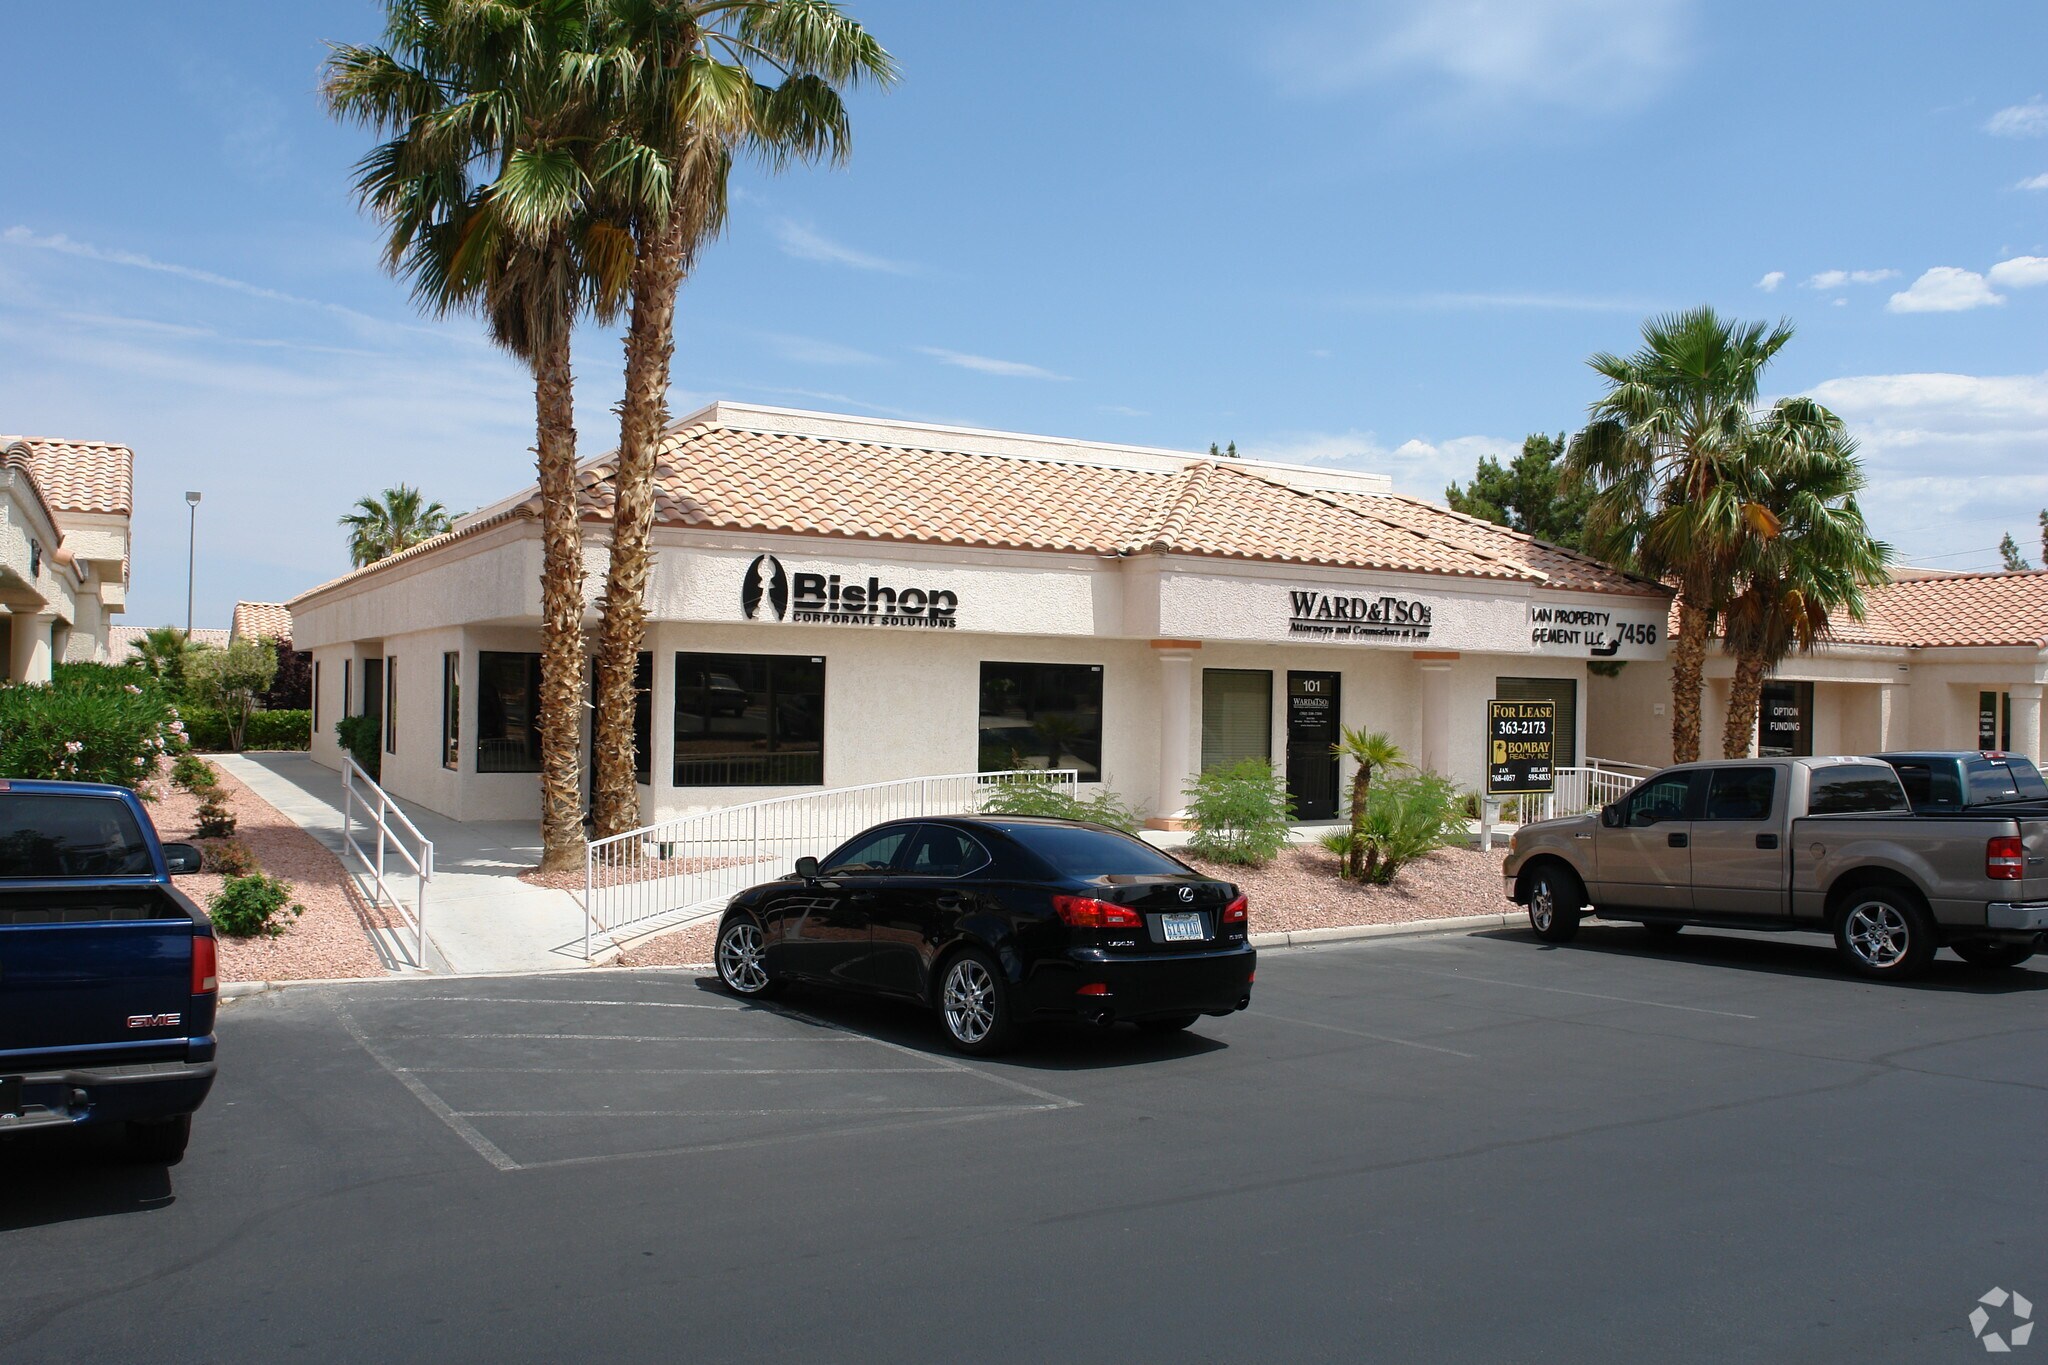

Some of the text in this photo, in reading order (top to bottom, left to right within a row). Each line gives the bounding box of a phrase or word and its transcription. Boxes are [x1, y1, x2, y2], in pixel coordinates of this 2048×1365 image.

[793, 572, 958, 619] Bishop
[793, 613, 957, 628] CORPORATE SOLUTIONS
[1554, 609, 1610, 626] PROPERTY
[1290, 622, 1333, 635] Attorneys
[1335, 625, 1352, 634] and
[1353, 626, 1400, 637] Counselors
[1412, 629, 1431, 638] Law
[1531, 628, 1582, 644] GEMENT
[1616, 622, 1657, 645] 7456
[1303, 680, 1321, 692] 101
[1493, 704, 1552, 718] FOR LEASE
[1773, 706, 1798, 716] OPTION
[1499, 721, 1546, 735] 363-2173
[1770, 721, 1800, 731] FUNDING
[1508, 741, 1551, 753] BOMBAY
